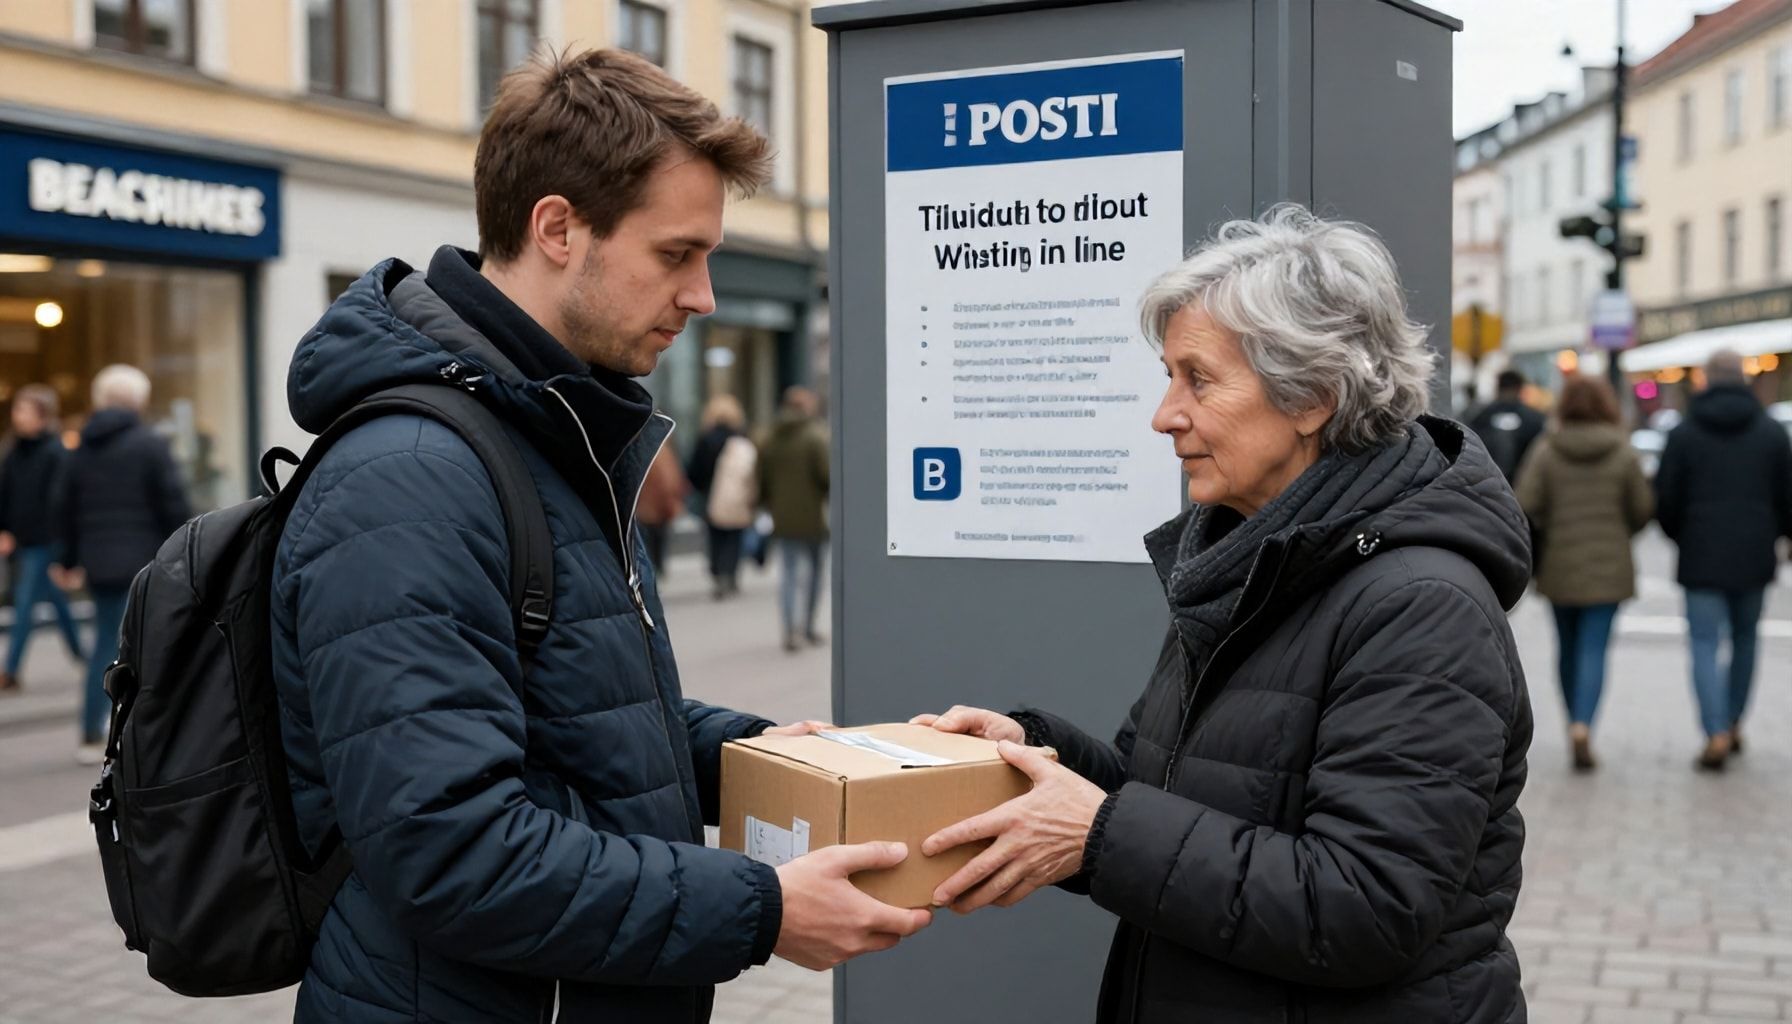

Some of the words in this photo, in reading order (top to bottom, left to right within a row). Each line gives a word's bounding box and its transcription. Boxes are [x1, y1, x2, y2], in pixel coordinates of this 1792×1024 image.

[968, 93, 1118, 146] POSTI
[1036, 199, 1065, 224] to
[1041, 239, 1065, 265] in
[1076, 236, 1125, 263] line
[923, 458, 946, 491] B
